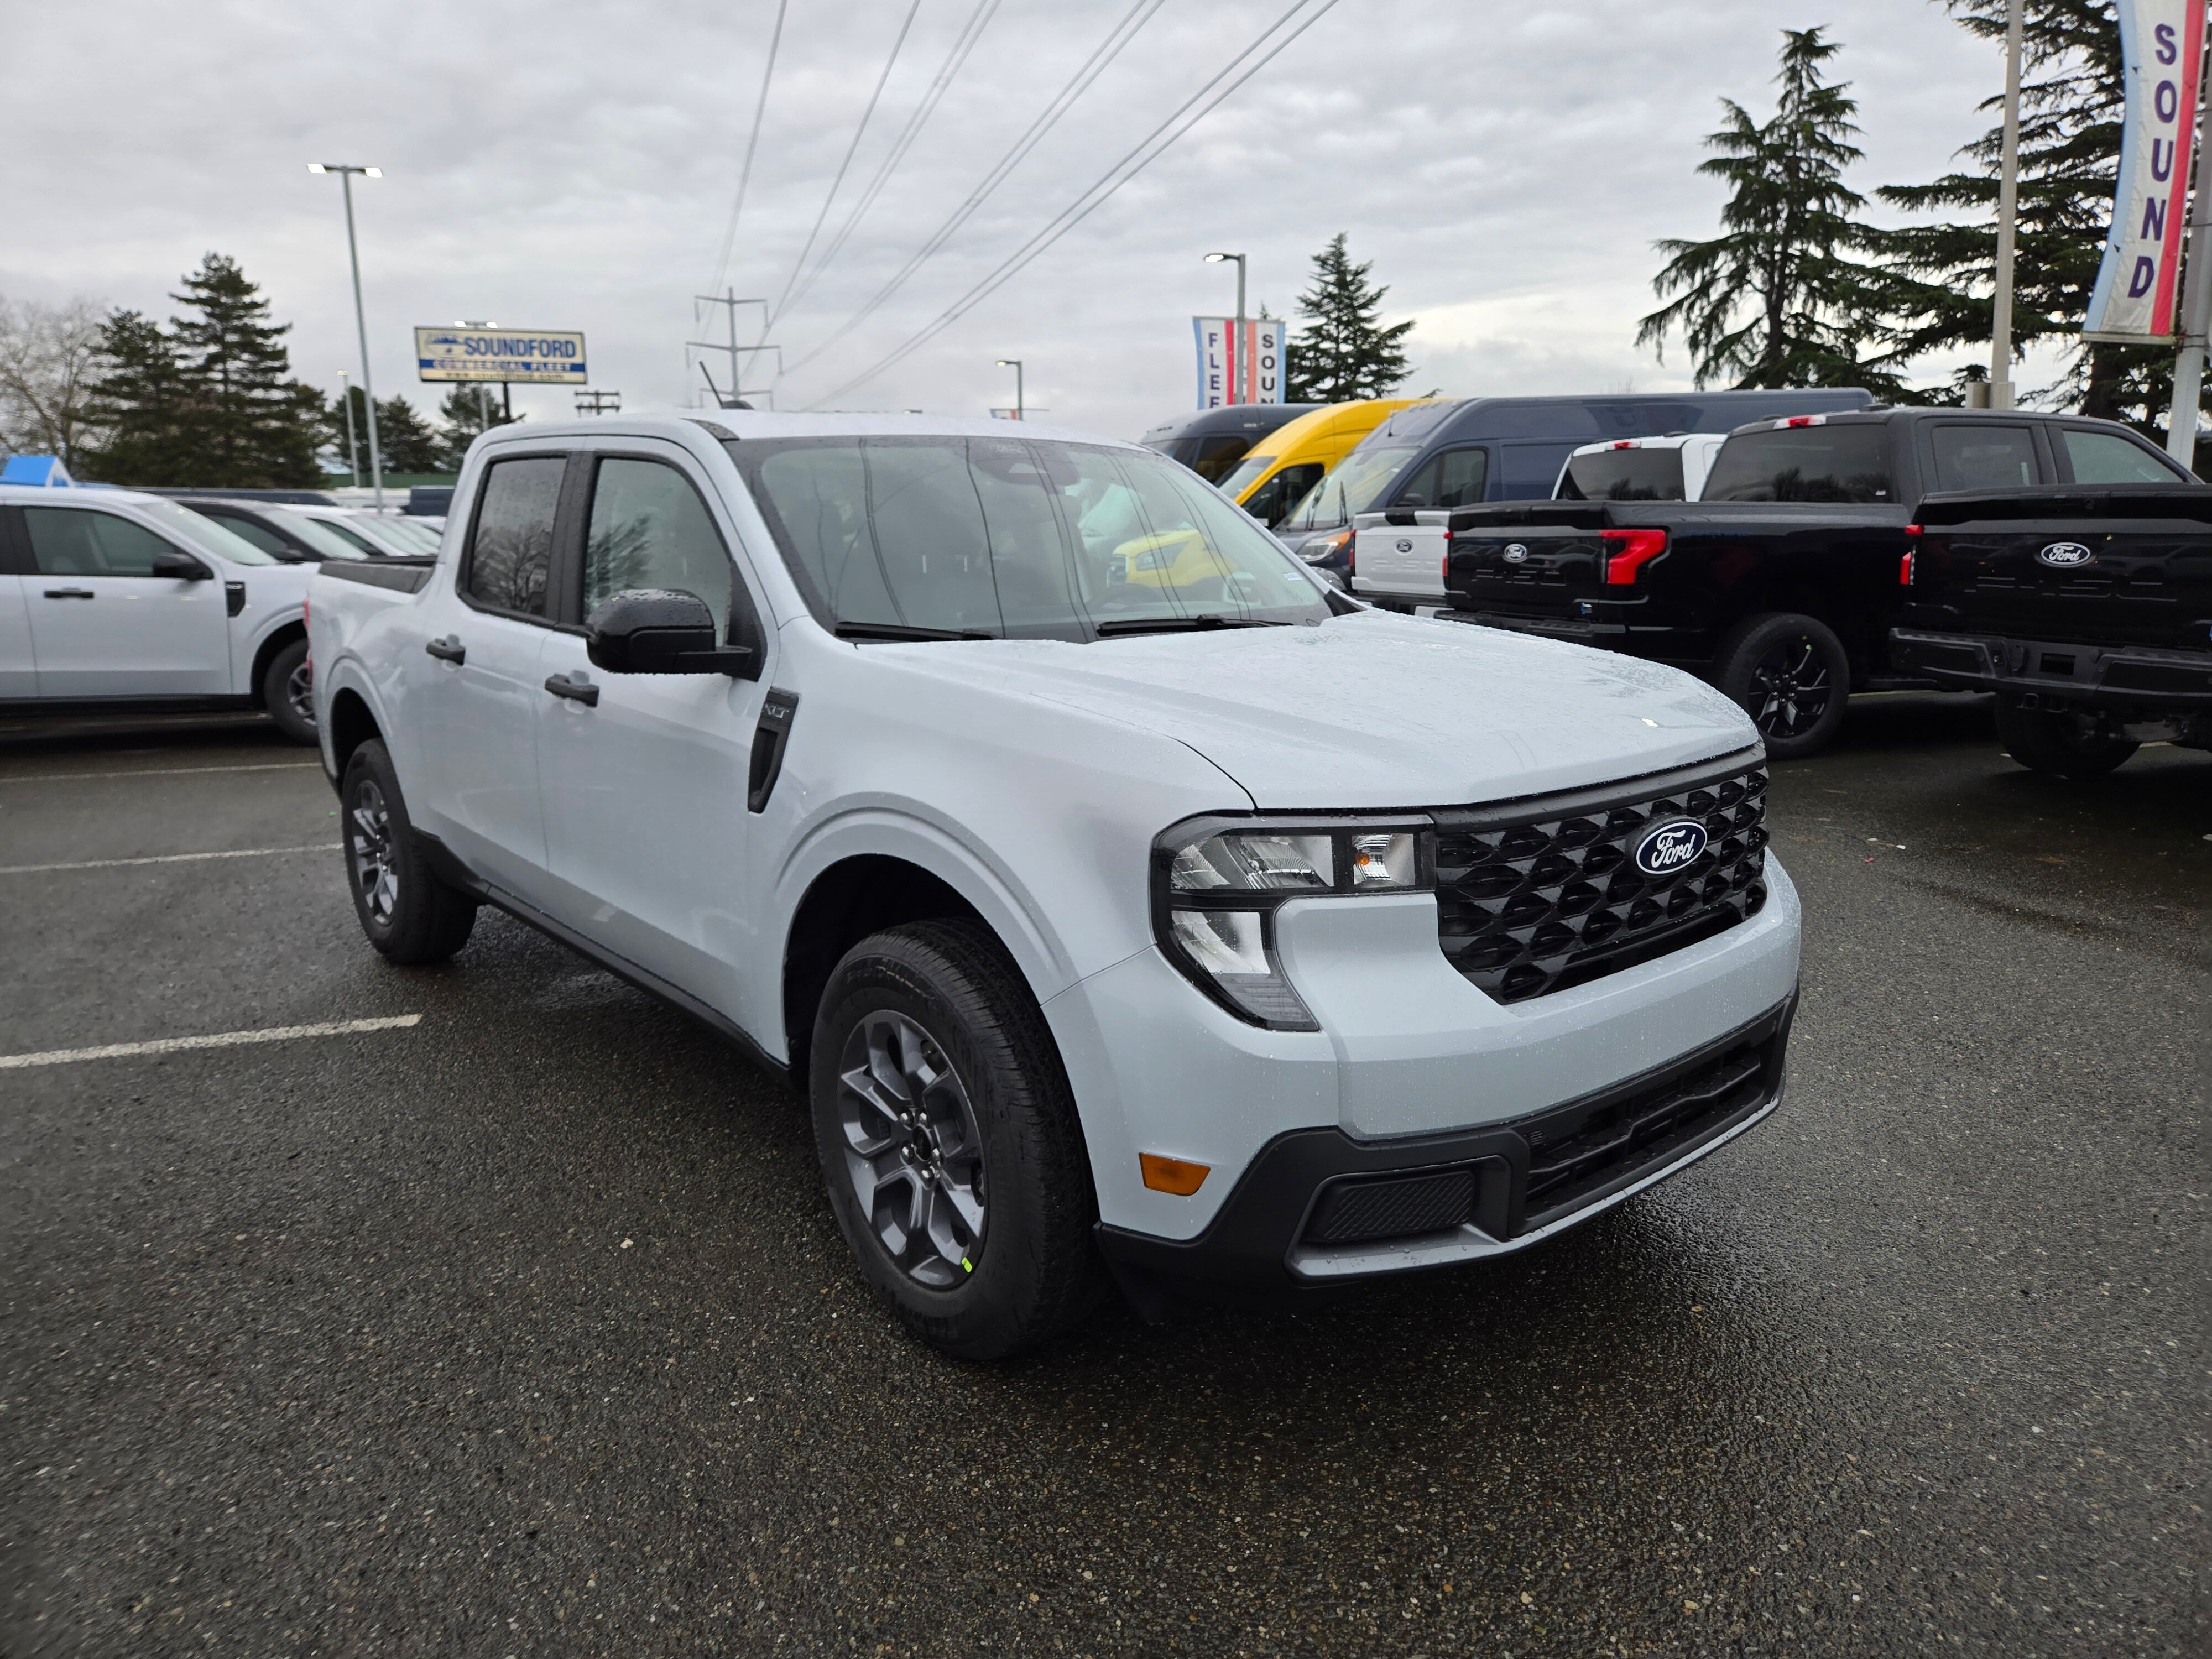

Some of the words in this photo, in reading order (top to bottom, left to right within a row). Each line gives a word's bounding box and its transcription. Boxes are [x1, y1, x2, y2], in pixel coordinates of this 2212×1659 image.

[2127, 23, 2178, 298] SOUND
[2048, 545, 2081, 561] Ford
[1651, 829, 1696, 868] Ford
